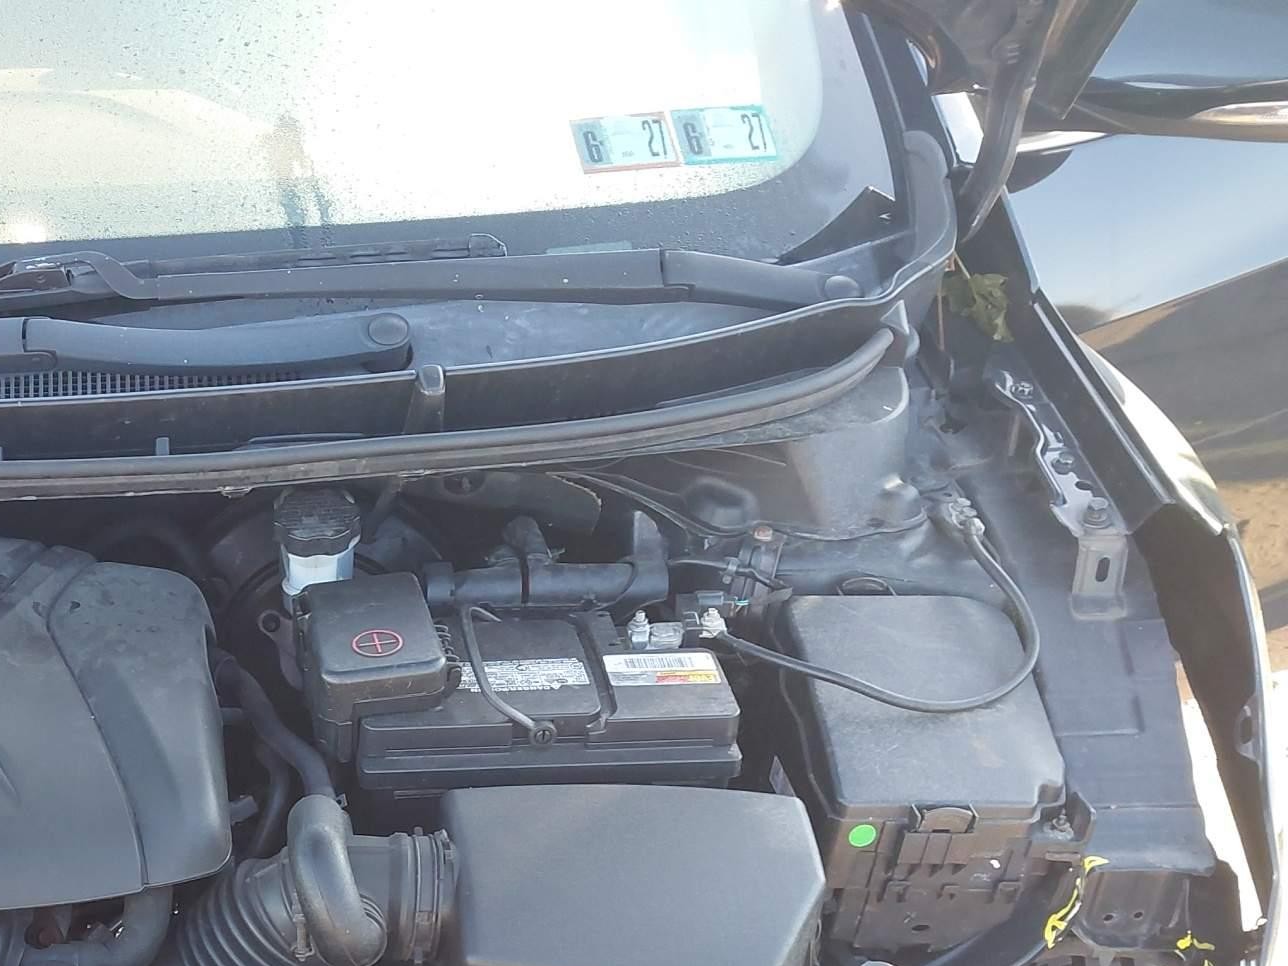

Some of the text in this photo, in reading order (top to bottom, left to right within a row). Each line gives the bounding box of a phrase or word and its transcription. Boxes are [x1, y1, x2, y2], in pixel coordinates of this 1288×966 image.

[582, 119, 668, 163] 6 27
[682, 112, 768, 155] 6 27
